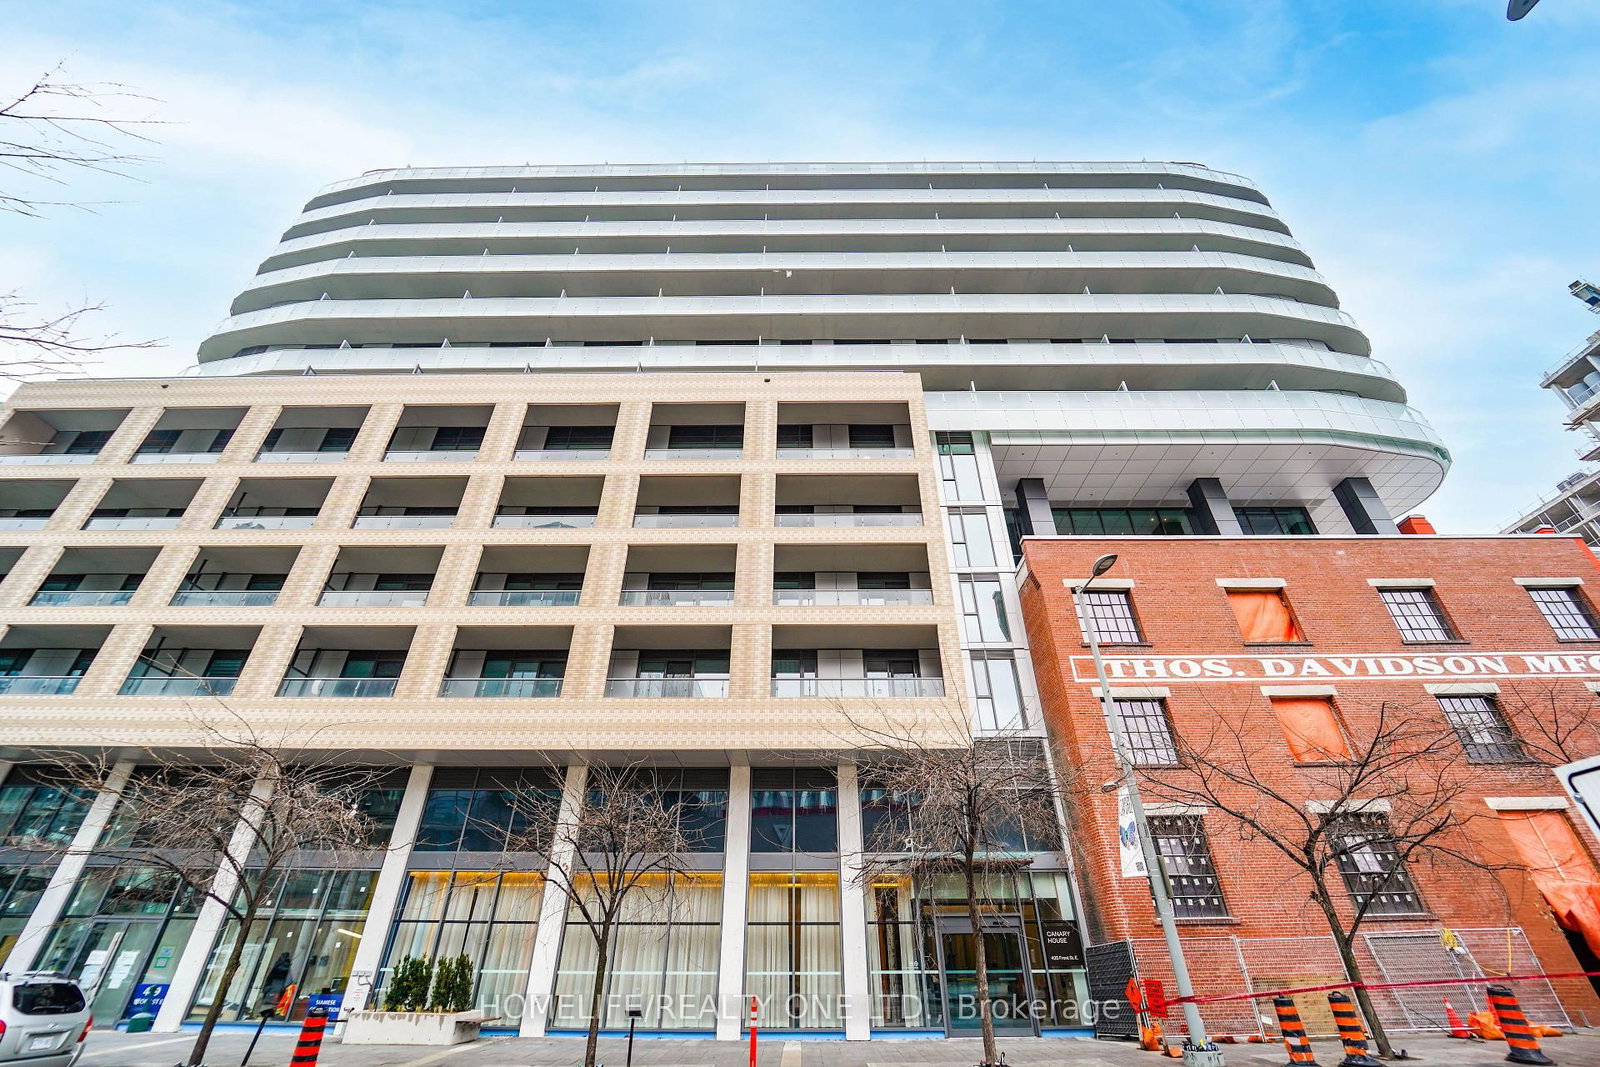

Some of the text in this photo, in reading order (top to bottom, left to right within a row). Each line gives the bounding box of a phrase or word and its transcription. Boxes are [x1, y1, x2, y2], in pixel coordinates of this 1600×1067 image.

[1101, 658, 1246, 678] THOS.
[1258, 656, 1509, 676] DAVIDSON
[142, 985, 162, 997] 49
